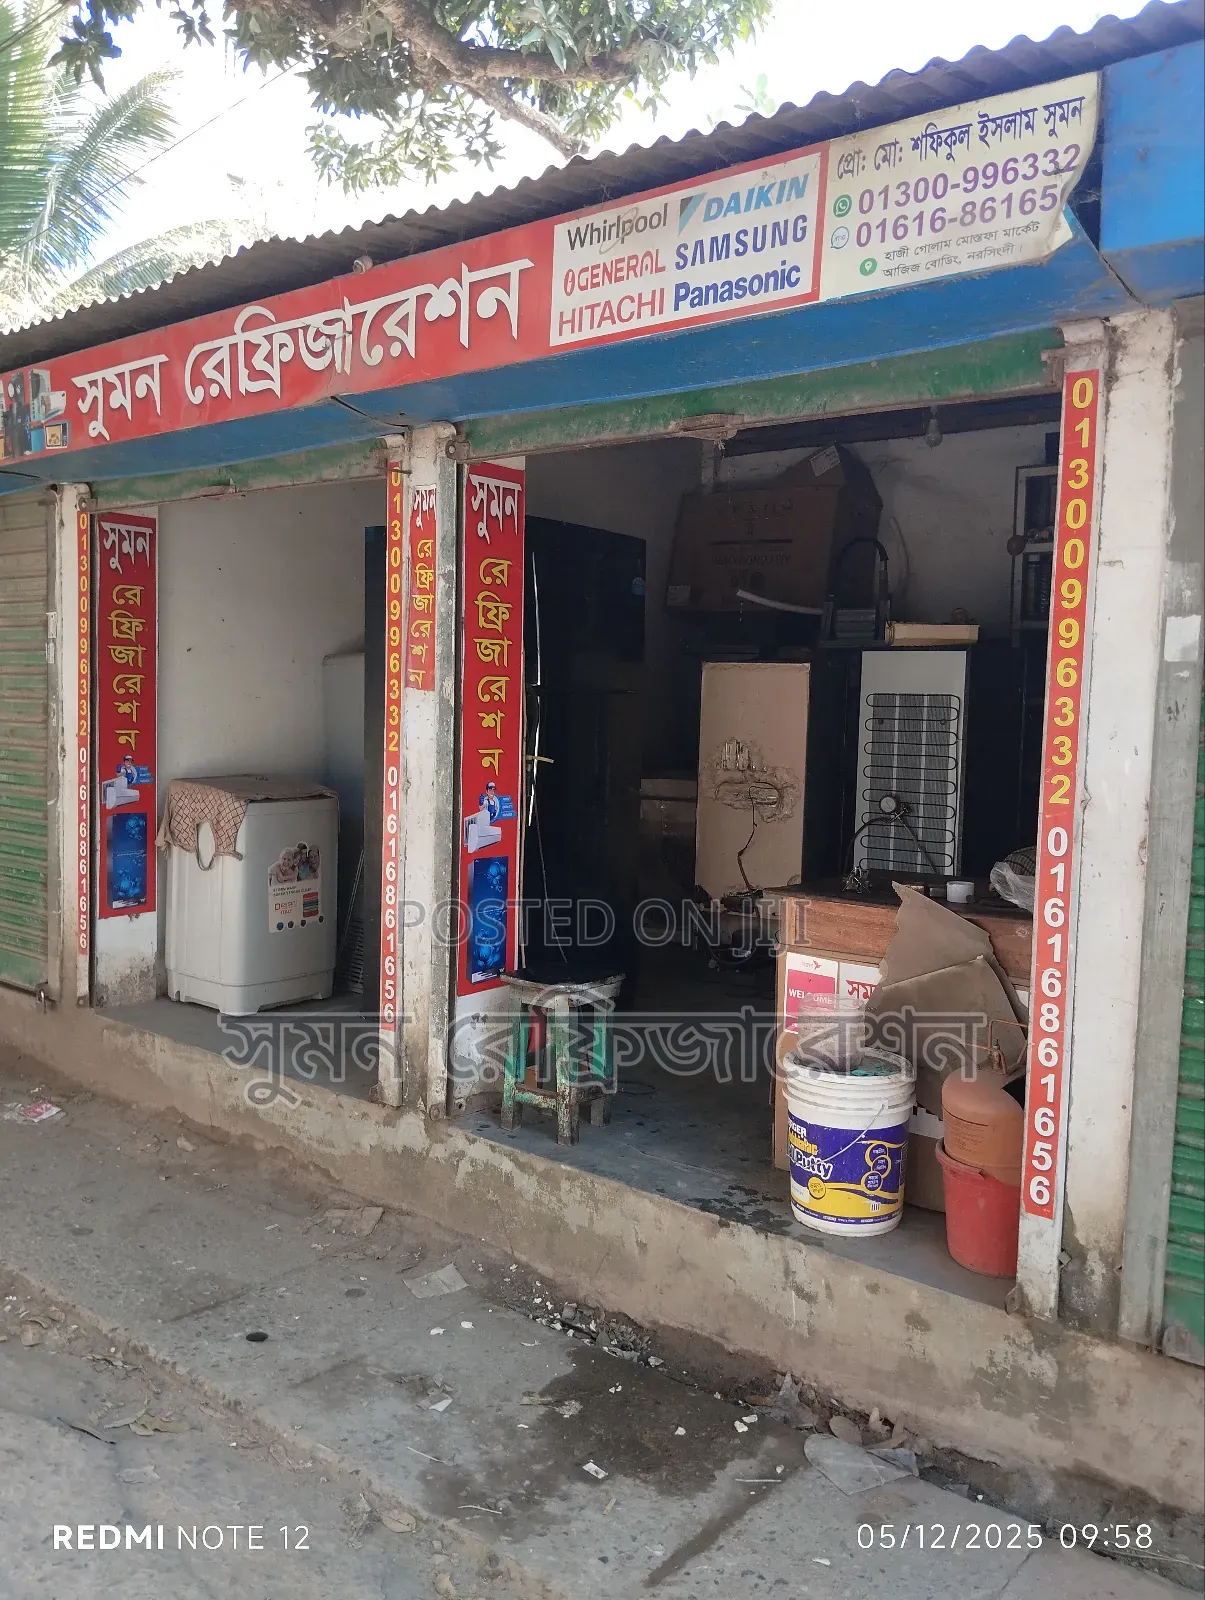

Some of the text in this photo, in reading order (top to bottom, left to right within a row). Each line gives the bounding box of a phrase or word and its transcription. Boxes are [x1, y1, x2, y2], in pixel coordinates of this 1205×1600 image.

[910, 121, 973, 163] শফিকুল
[977, 107, 1039, 149] ইসলাম
[1042, 95, 1086, 139] সুমন
[702, 172, 810, 223] DAIKIN
[858, 143, 1082, 215] 01300-996332
[567, 202, 669, 252] Whirlpool
[674, 213, 809, 271] SAMSUNG
[883, 242, 909, 261] হাজী
[914, 238, 953, 256] গোলাম
[966, 242, 1015, 261] নরসিংদী
[558, 287, 665, 337] HITACHI
[673, 259, 801, 312] Panasonic
[72, 258, 535, 442] সুমন রেফ্রিজারেশন
[413, 483, 437, 532] সুমন
[469, 473, 522, 544] সুমন
[100, 521, 154, 574] সুমন
